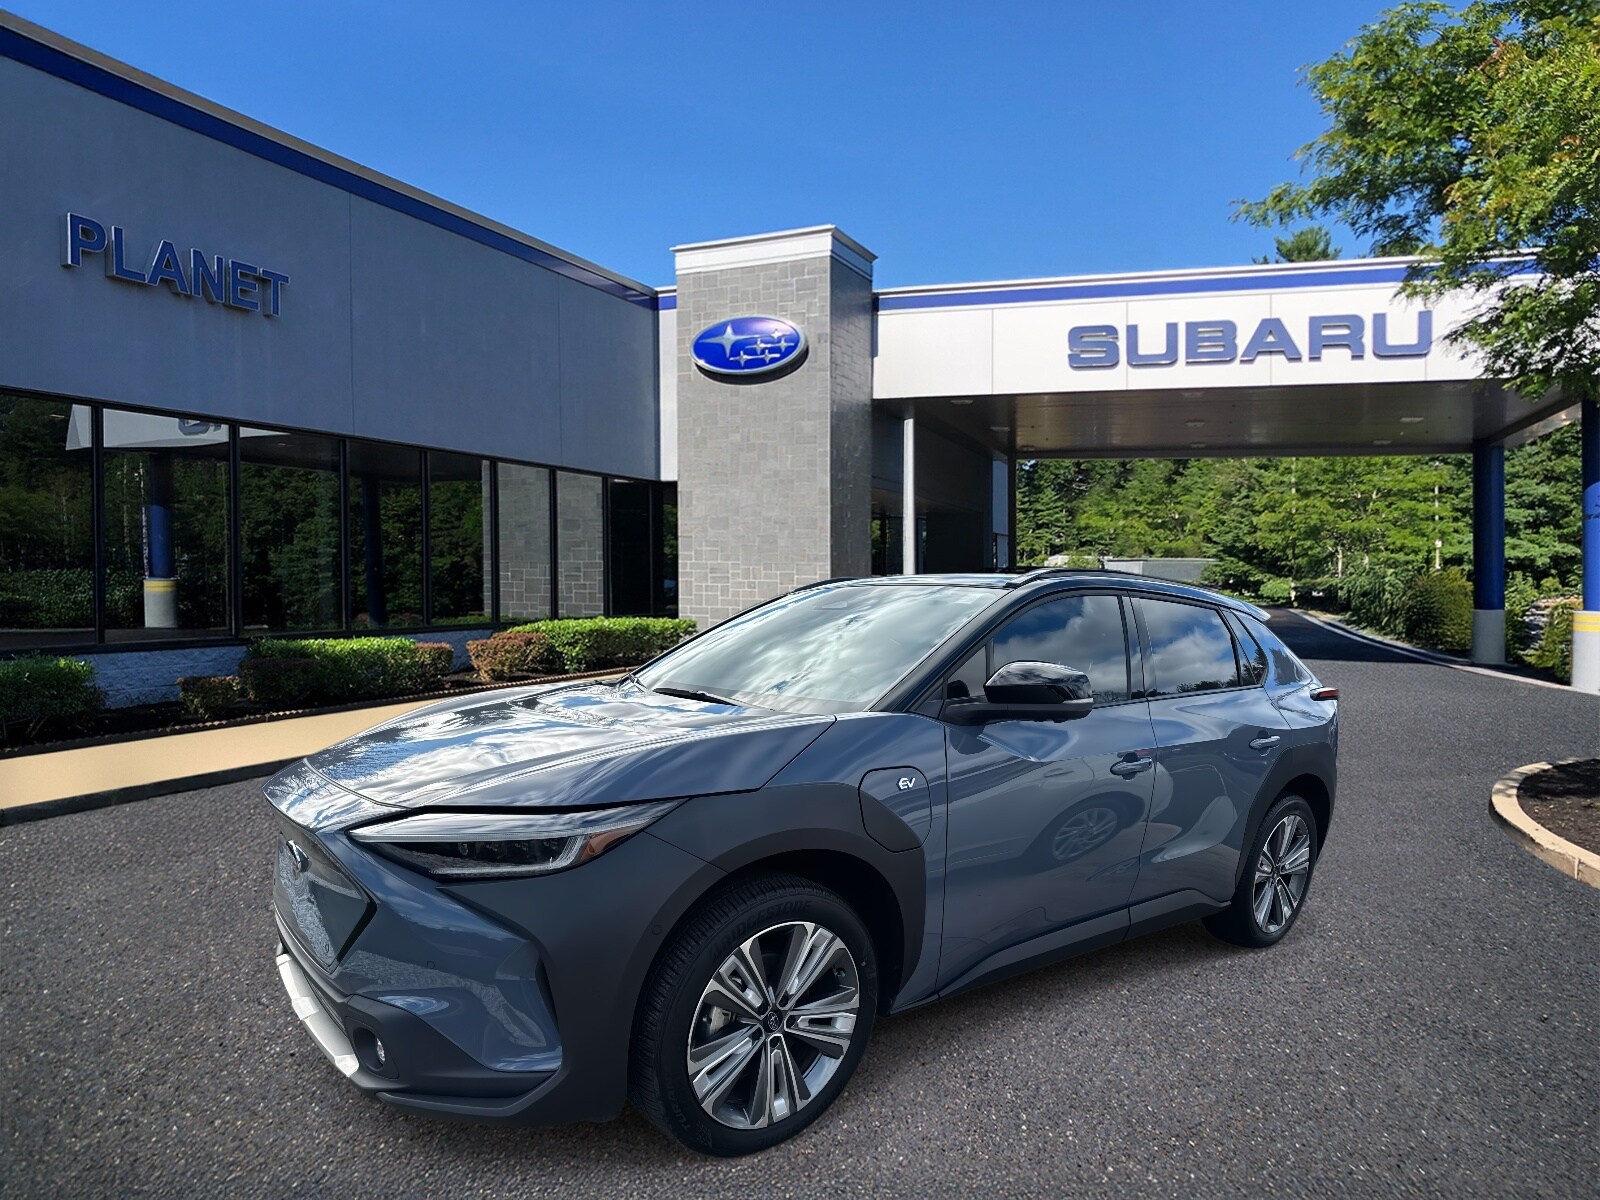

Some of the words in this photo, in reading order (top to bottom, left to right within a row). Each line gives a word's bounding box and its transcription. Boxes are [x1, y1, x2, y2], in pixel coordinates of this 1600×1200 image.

[65, 210, 291, 318] PLANET
[1067, 310, 1433, 369] SUBARU
[898, 777, 916, 789] EV
